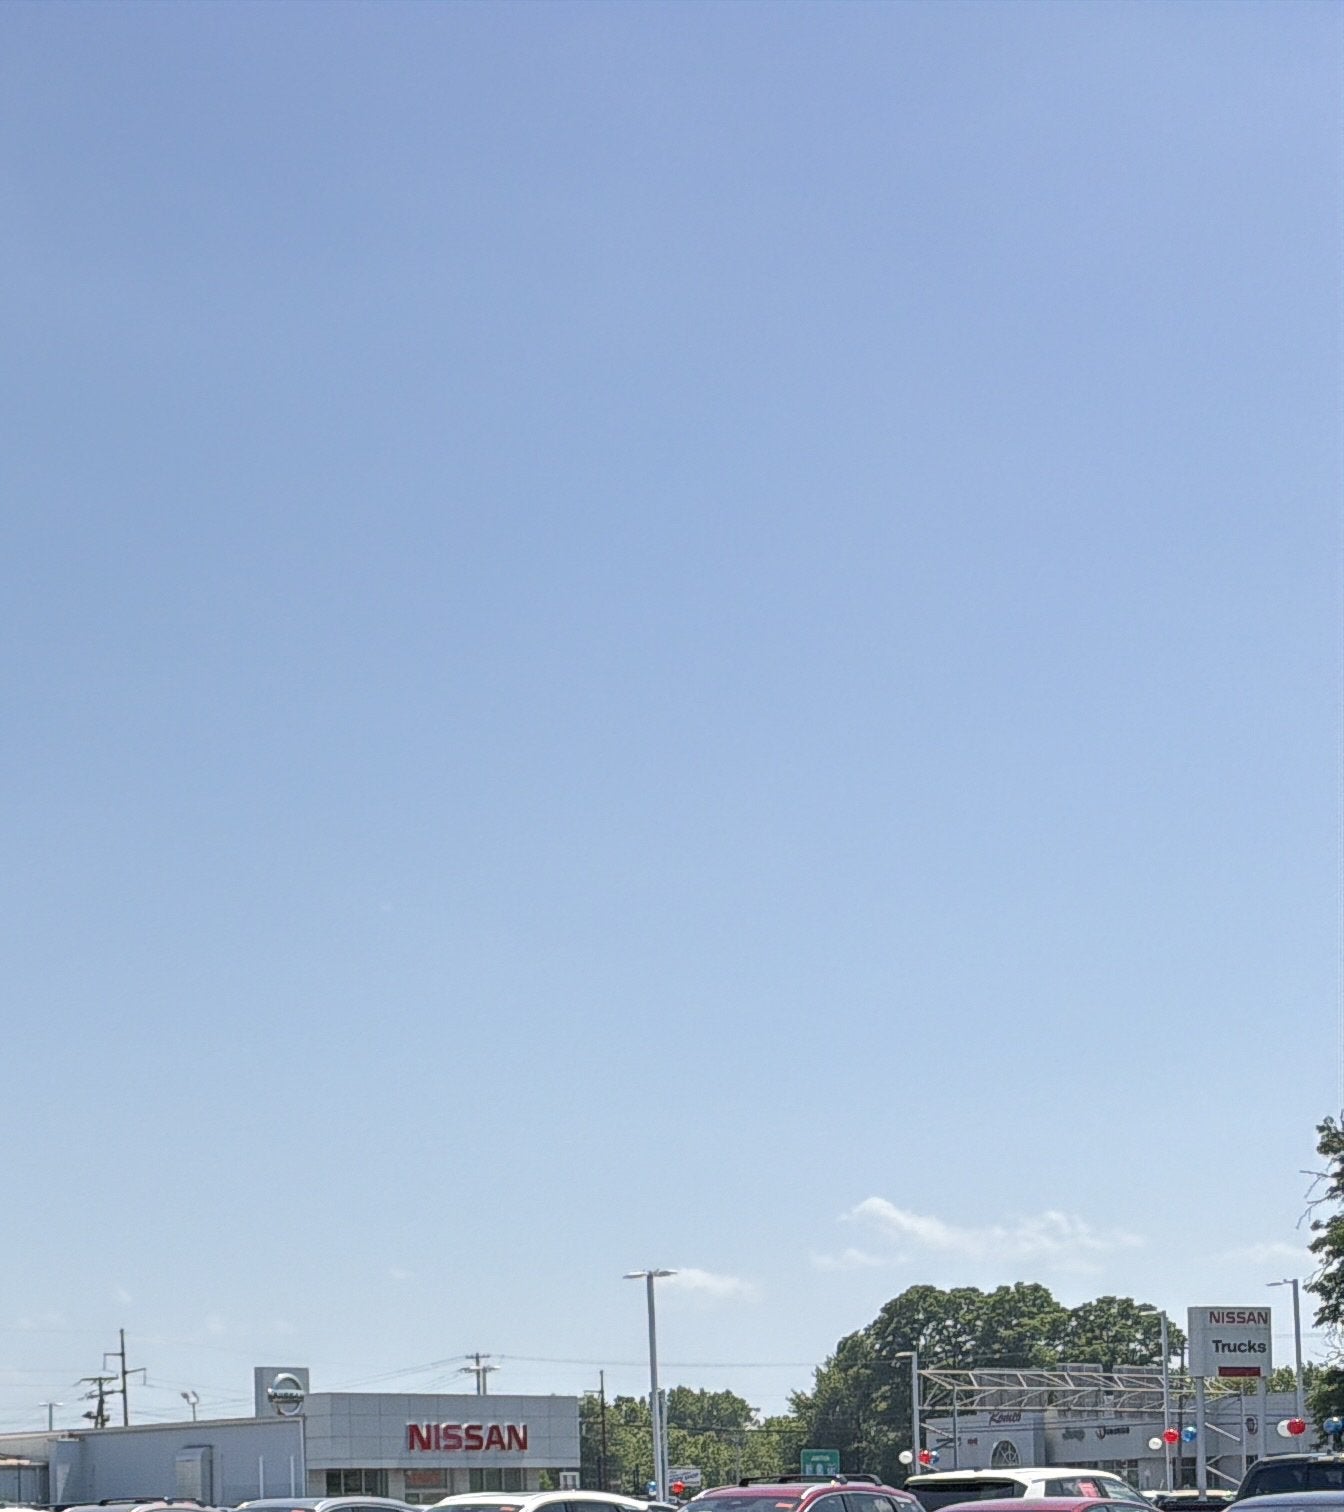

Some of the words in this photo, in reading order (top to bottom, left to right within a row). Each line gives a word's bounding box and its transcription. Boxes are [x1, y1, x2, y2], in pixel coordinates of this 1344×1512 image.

[1209, 1311, 1268, 1325] NISSAN
[1212, 1339, 1267, 1353] Trucks
[407, 1423, 529, 1451] NISSAN
